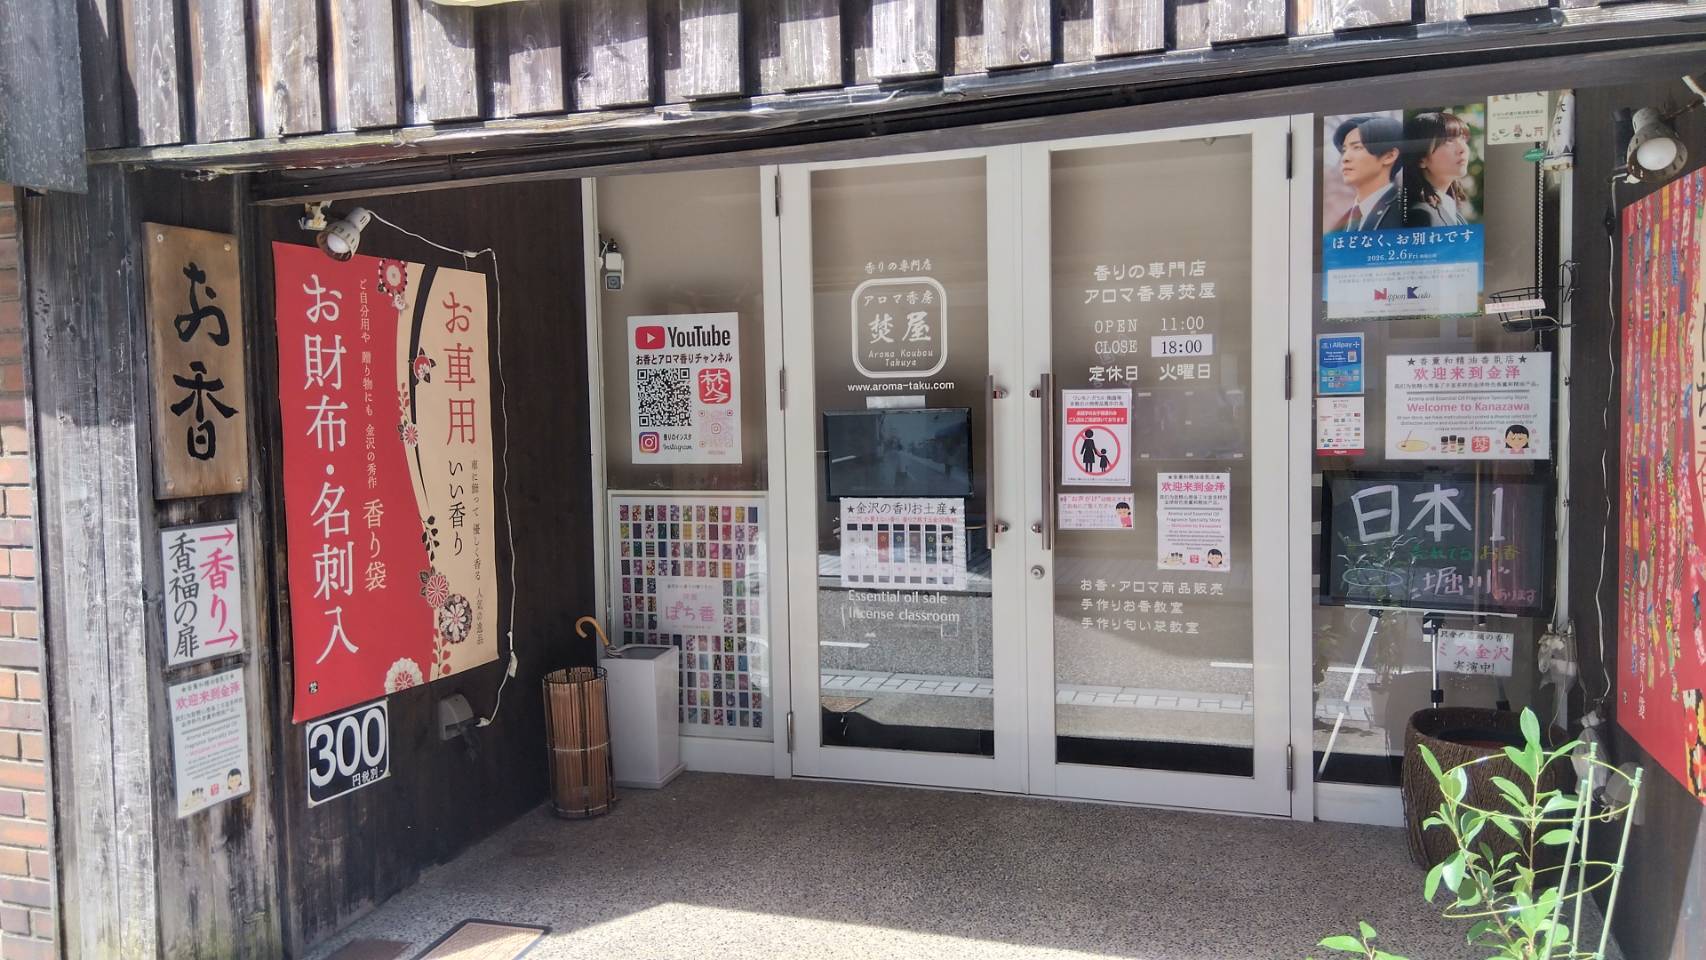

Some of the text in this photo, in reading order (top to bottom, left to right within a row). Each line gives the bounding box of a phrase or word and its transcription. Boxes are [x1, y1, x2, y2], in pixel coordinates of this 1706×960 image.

[1332, 229, 1474, 249] ほどなく、お別れです
[865, 258, 932, 274] 香りの専門店
[1094, 259, 1206, 281] 香りの専門店
[864, 290, 934, 306] アロマ香房
[1084, 282, 1216, 304] アロマ香房焚屋
[868, 311, 932, 344] 焚屋
[1094, 316, 1204, 334] OPEN 11:00
[668, 325, 731, 348] YouTube
[869, 349, 933, 359] Aroma Koubou
[1094, 340, 1202, 355] CLOSE 18:00
[170, 262, 239, 460] お香
[636, 352, 733, 366] お香とアロマ香りチャンネル
[885, 359, 917, 368] Takuya
[1088, 363, 1211, 383] 定休日 火曜日
[1414, 365, 1521, 381] 欢迎来到金泽
[847, 380, 955, 392] www.aroma-taku.com
[1407, 401, 1530, 412] Welcome to Kanazawa
[442, 291, 477, 556] お車用 いい香り
[302, 274, 359, 665] お財布・名刺入
[856, 502, 948, 515] 金沢の香りお土産
[362, 498, 387, 591] 香り袋
[168, 531, 200, 659] 香福の扉
[199, 547, 235, 633] 香り
[1080, 578, 1224, 596] お香・アロマ商品販売
[848, 589, 948, 604] Essential oil sale
[899, 608, 960, 622] classroom
[1081, 598, 1185, 614] 手作りお香教室
[1081, 617, 1200, 634] 手作り匂い袋教室
[1439, 643, 1512, 661] ミス金沢
[310, 708, 386, 787] 300
